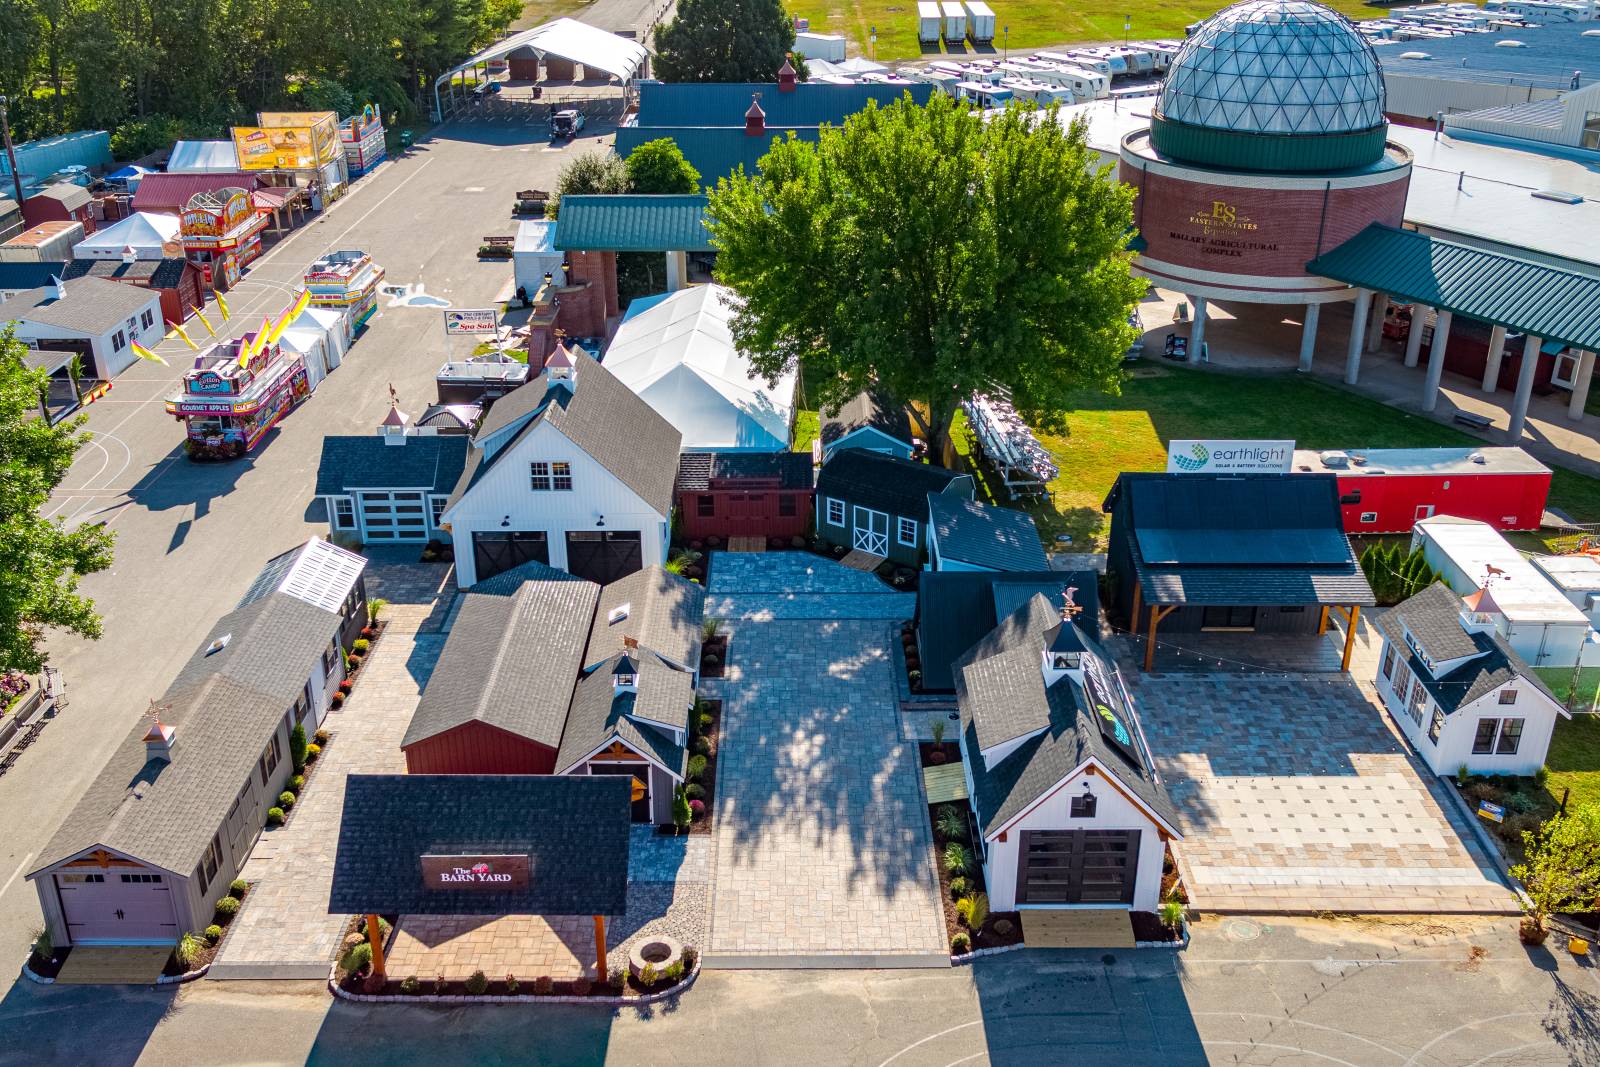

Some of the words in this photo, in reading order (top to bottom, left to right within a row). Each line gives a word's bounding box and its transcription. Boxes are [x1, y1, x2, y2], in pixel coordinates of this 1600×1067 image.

[1227, 222, 1258, 230] STATES
[1169, 231, 1207, 244] MALLARY
[1210, 239, 1279, 251] AGRICULTURAL
[1201, 247, 1243, 257] COMPLEX
[1213, 447, 1285, 463] earthlight
[453, 867, 471, 875] The
[440, 873, 475, 882] BARN
[477, 873, 512, 882] YARD
